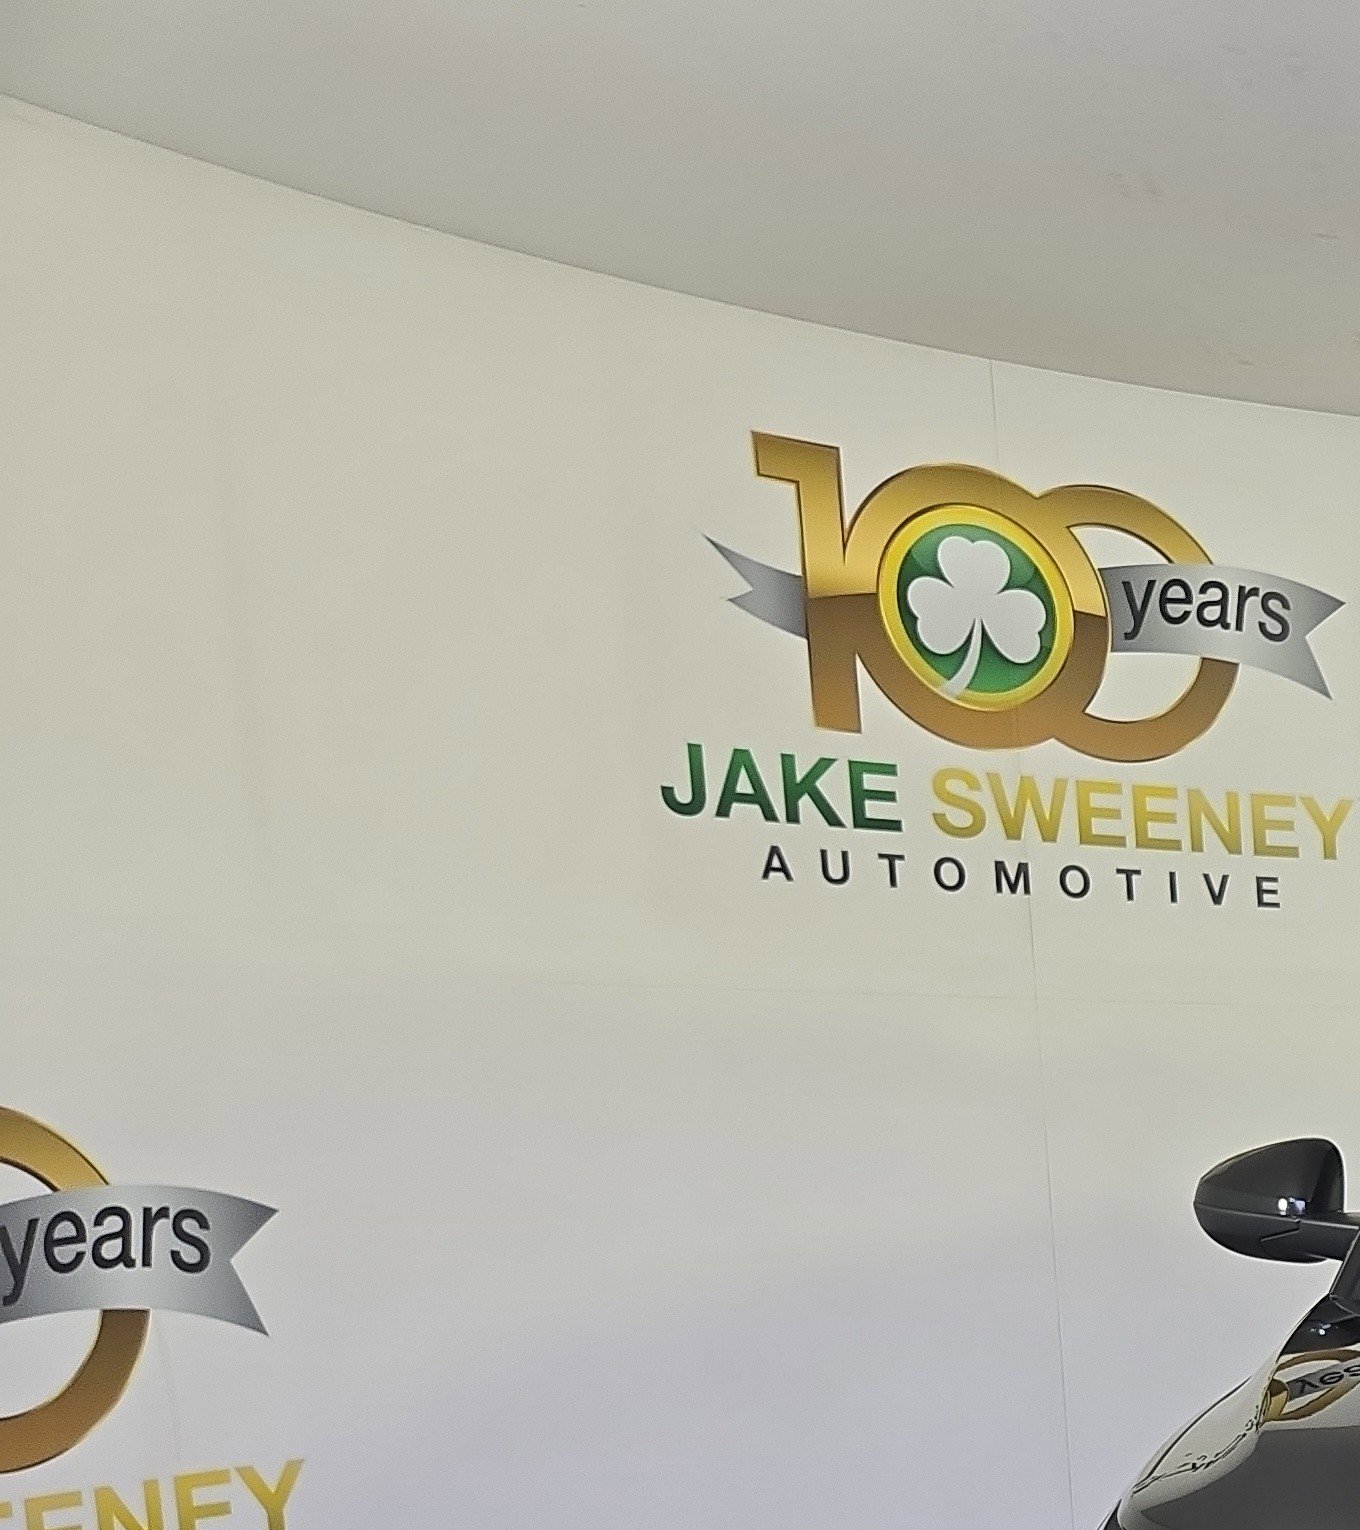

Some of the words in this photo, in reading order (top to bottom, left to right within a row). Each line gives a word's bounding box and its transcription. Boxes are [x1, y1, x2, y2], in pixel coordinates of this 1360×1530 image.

[1122, 577, 1292, 642] years
[661, 742, 902, 832] JAKE
[931, 767, 1353, 860] SWEENEY
[761, 844, 1281, 908] AUTOMOTIVE
[0, 1205, 211, 1306] years
